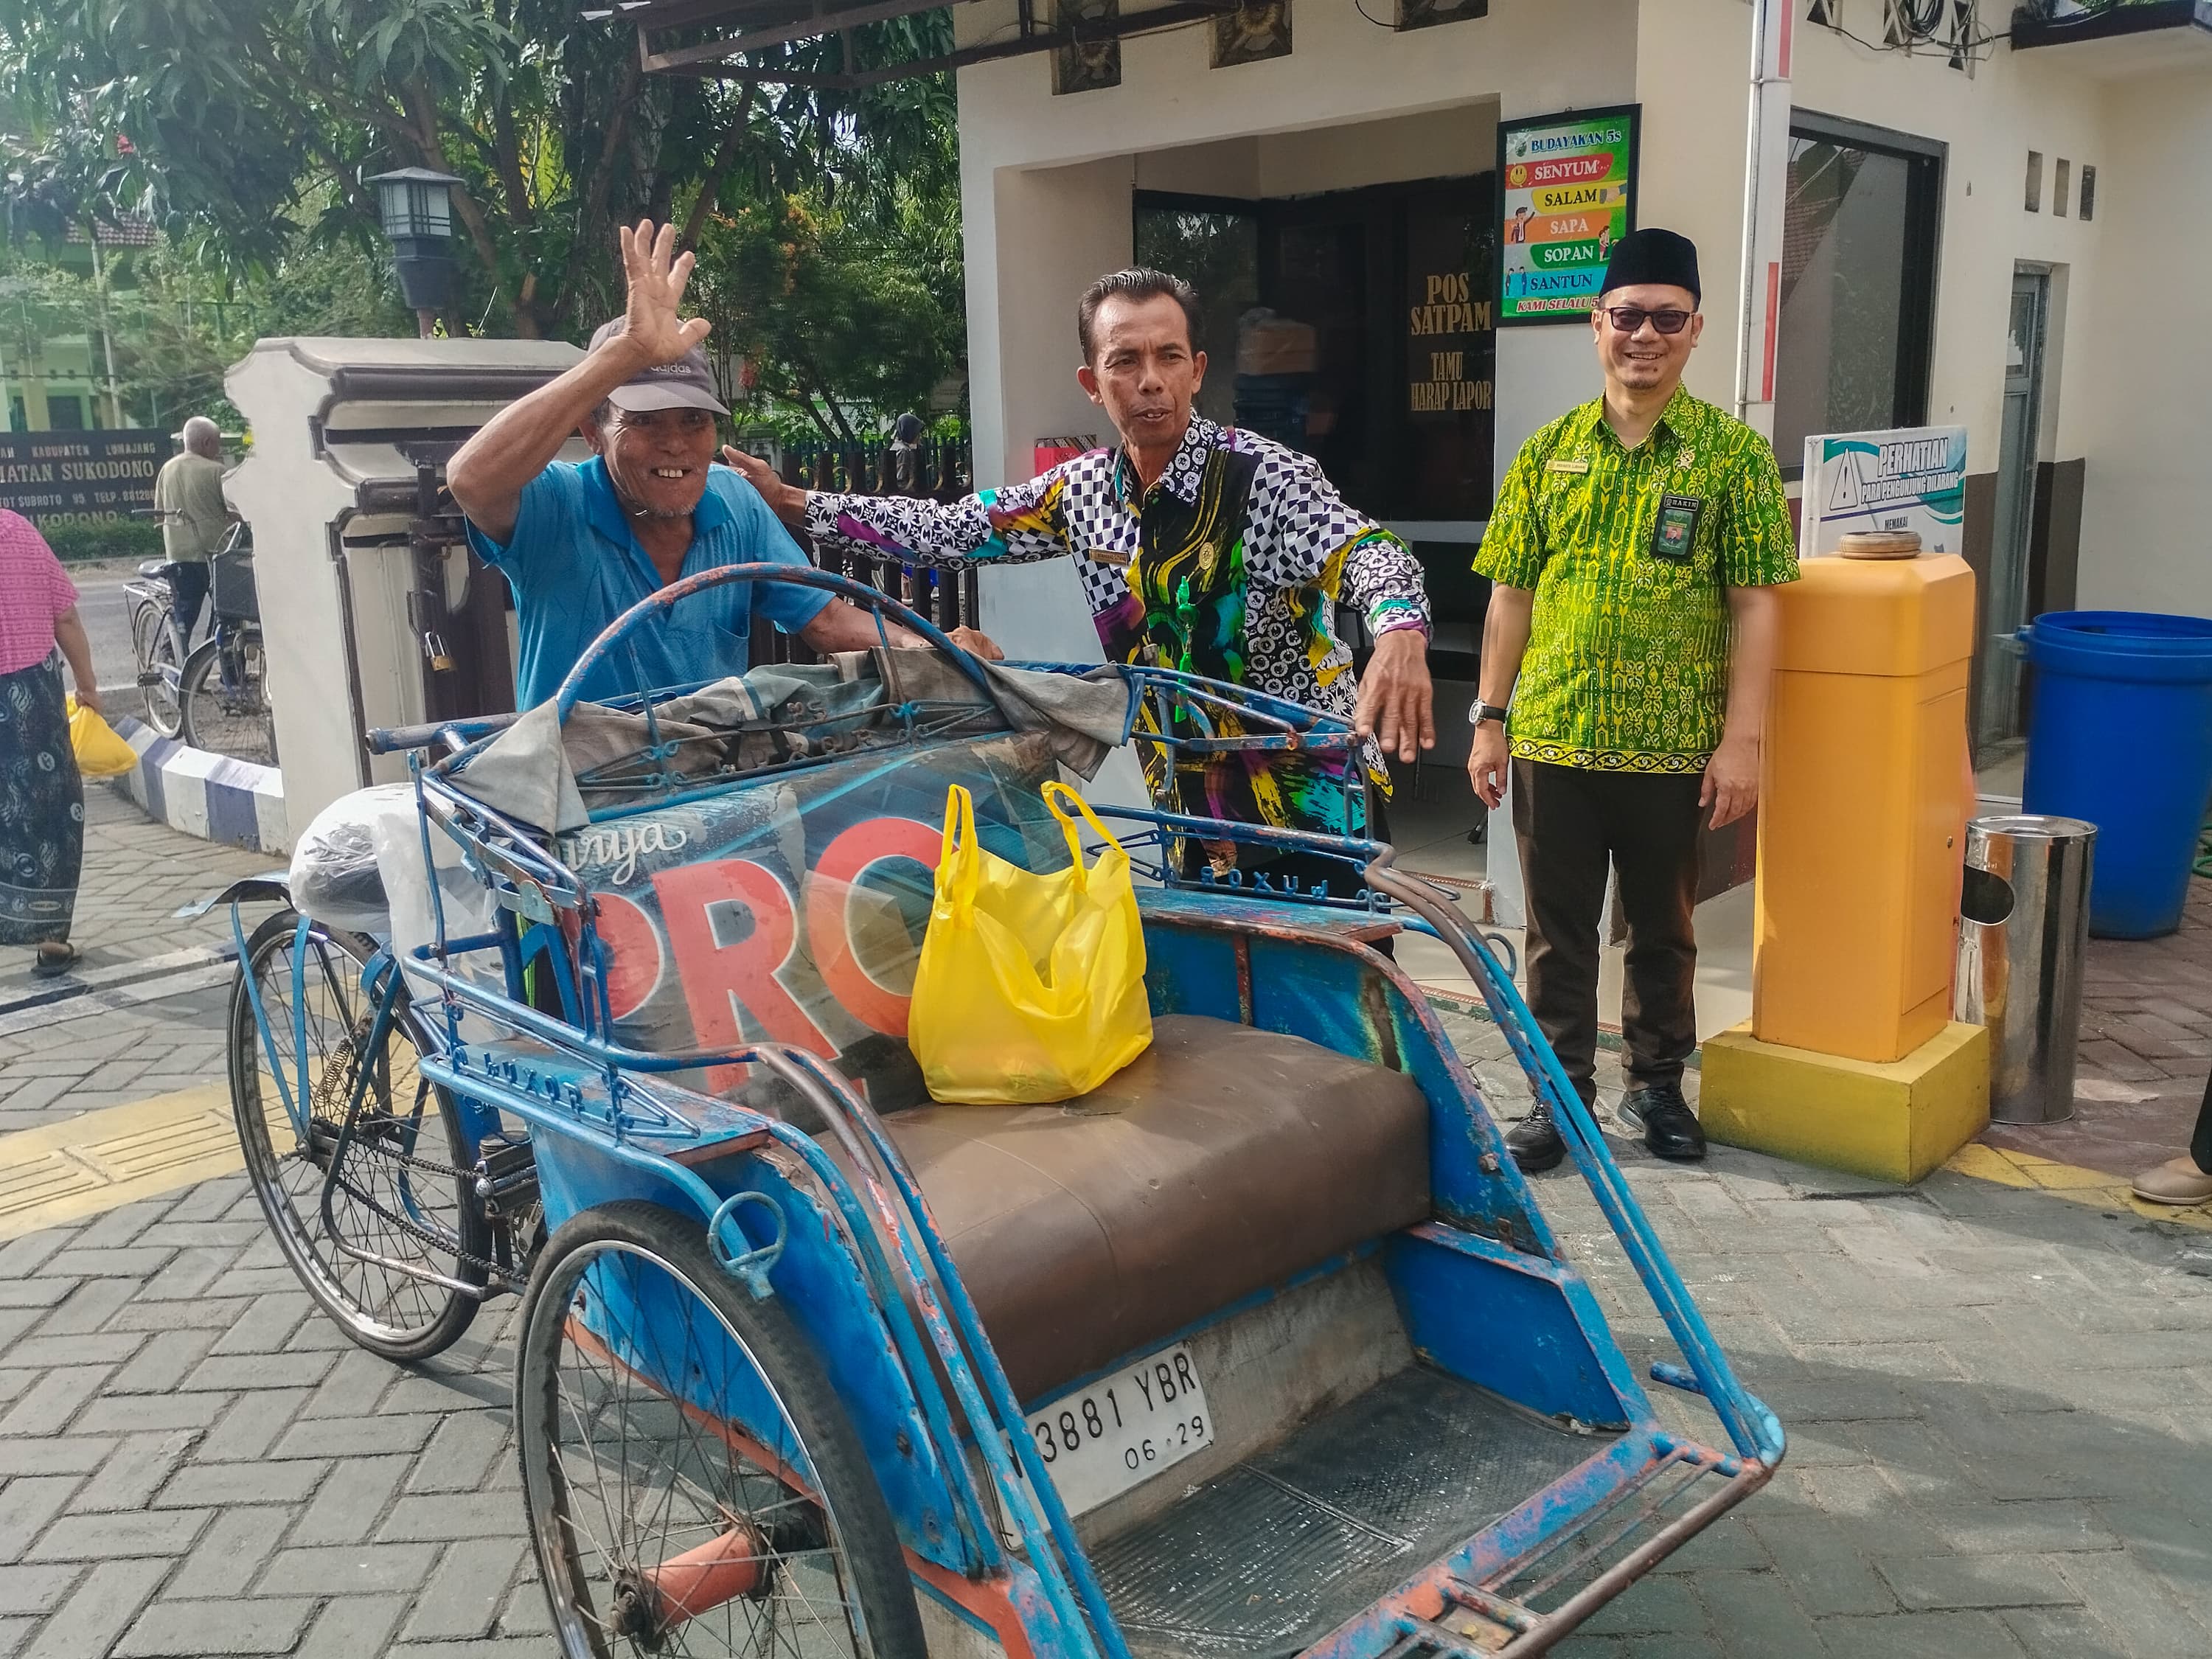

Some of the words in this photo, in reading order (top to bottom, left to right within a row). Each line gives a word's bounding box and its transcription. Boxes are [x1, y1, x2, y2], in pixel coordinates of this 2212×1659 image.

[1531, 131, 1603, 153] BUDAYAKAN
[1534, 159, 1599, 181] SENYUM
[1545, 188, 1598, 207] SALAM
[1550, 219, 1589, 235] SAPA
[1544, 246, 1593, 262] SOPAN
[1427, 272, 1470, 305] POS
[1530, 274, 1593, 291] SANTUN
[1517, 298, 1547, 312] KAMI
[1548, 296, 1590, 310] SELALU
[1411, 301, 1492, 335] SATPAM
[1430, 351, 1464, 381] TAMU
[1411, 381, 1450, 411] HARAP
[1453, 380, 1492, 410] LAPOR
[32, 445, 89, 458] KABUPATEN
[105, 442, 156, 456] LUMAJANG
[1877, 438, 1949, 478] PERHATIAN
[61, 460, 154, 481] SUKODONO
[1860, 481, 1881, 504] PARA
[1881, 476, 1927, 502] PENGUNJUNG
[1927, 471, 1958, 491] DILARANG
[18, 494, 63, 507] SUBROTO
[1884, 517, 1908, 531] MEMAKAI
[1035, 1388, 1122, 1463] 3881
[1134, 1352, 1196, 1412] YBR
